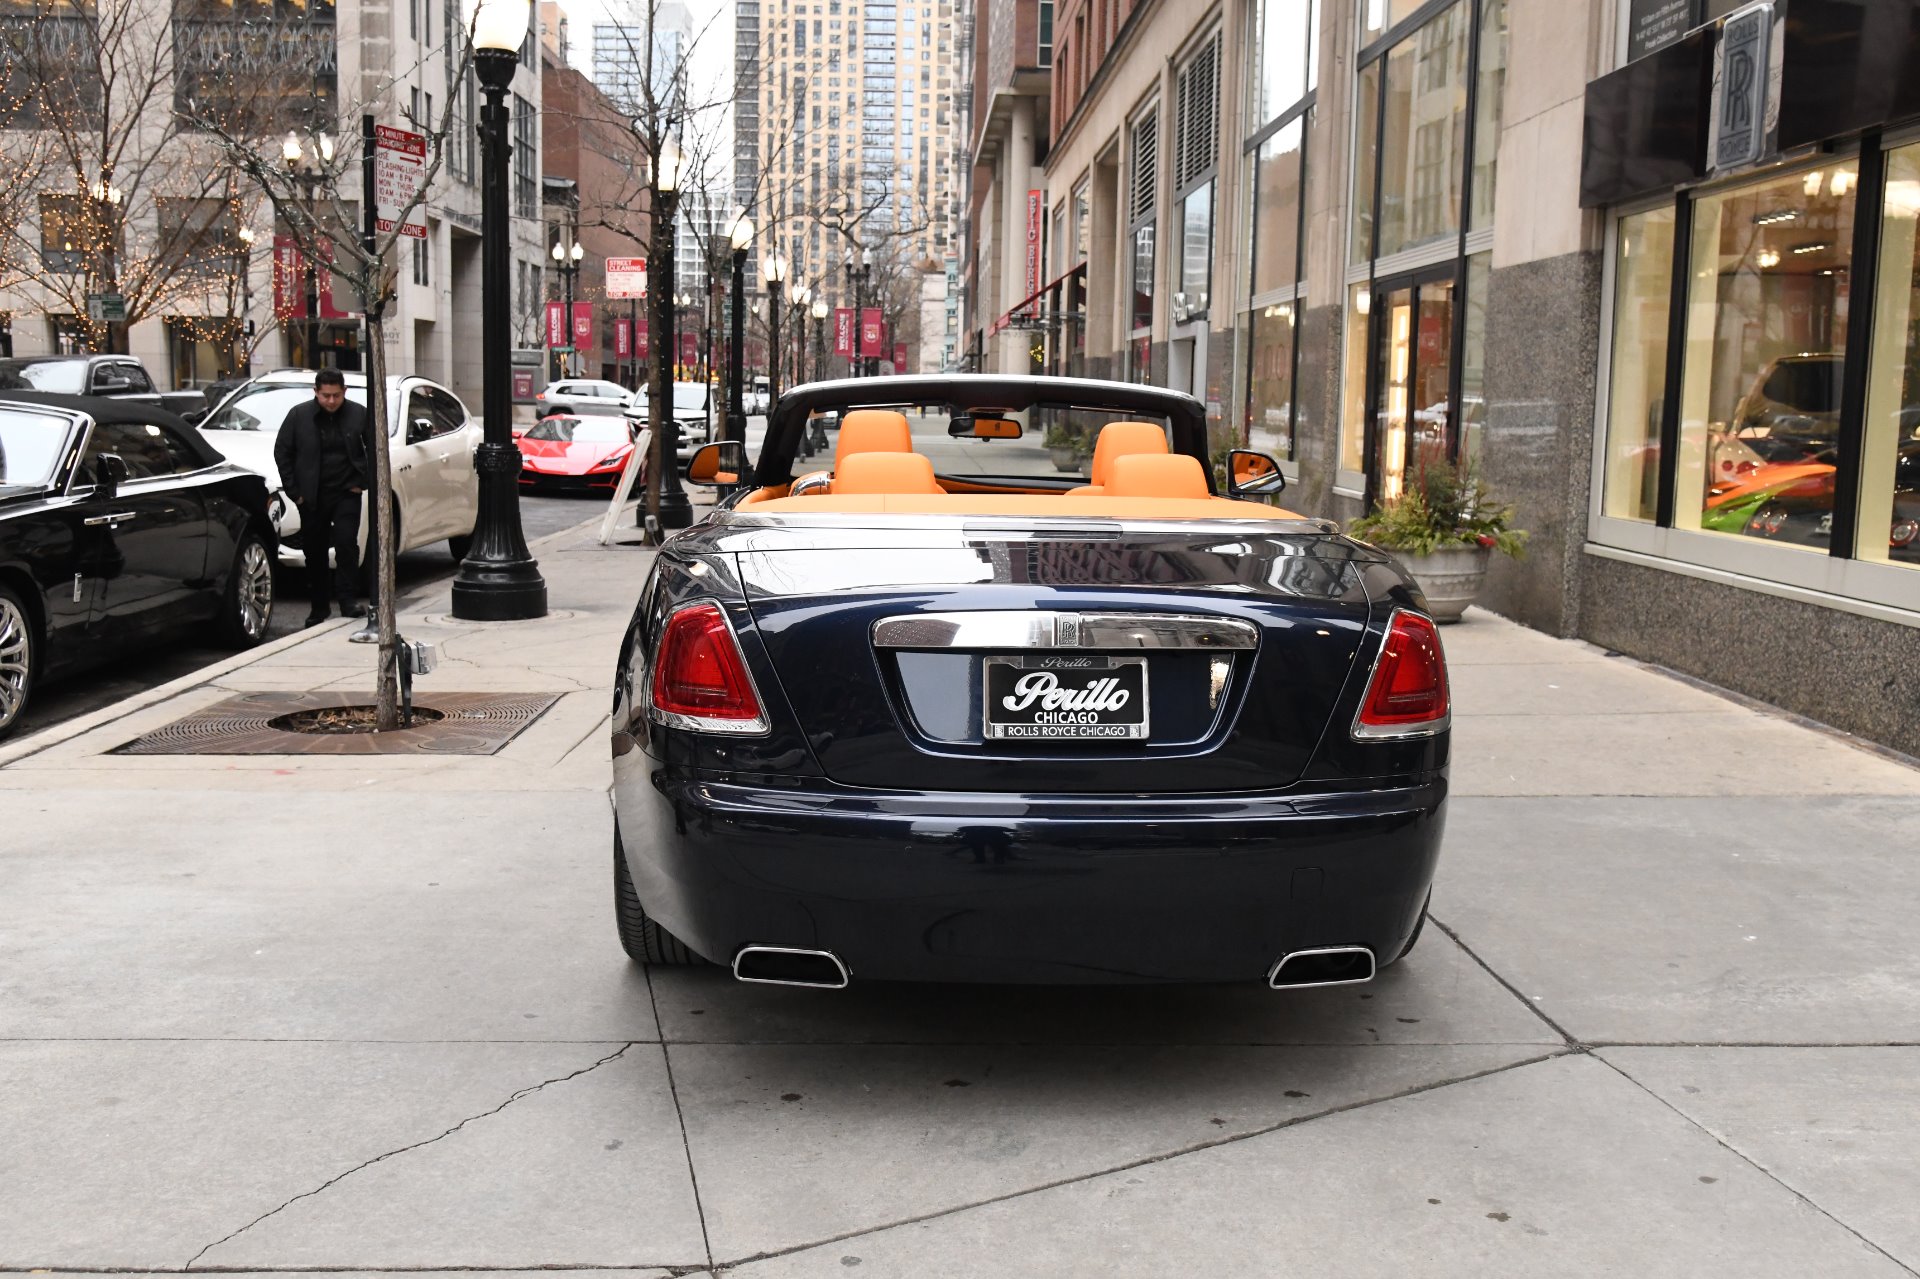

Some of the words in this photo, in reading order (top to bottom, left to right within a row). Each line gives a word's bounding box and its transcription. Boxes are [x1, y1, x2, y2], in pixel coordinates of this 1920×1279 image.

[1729, 19, 1759, 45] ROLLS
[1718, 136, 1751, 160] ROYCE
[401, 223, 423, 237] ZONE
[838, 313, 846, 351] WELCOME
[1040, 656, 1092, 668] Perillo
[1002, 671, 1130, 711] Perillo
[1034, 711, 1099, 724] CHICAGO
[1008, 726, 1039, 736] ROLLS
[1042, 726, 1077, 736] ROYCE
[1079, 726, 1126, 736] CHICAGO
